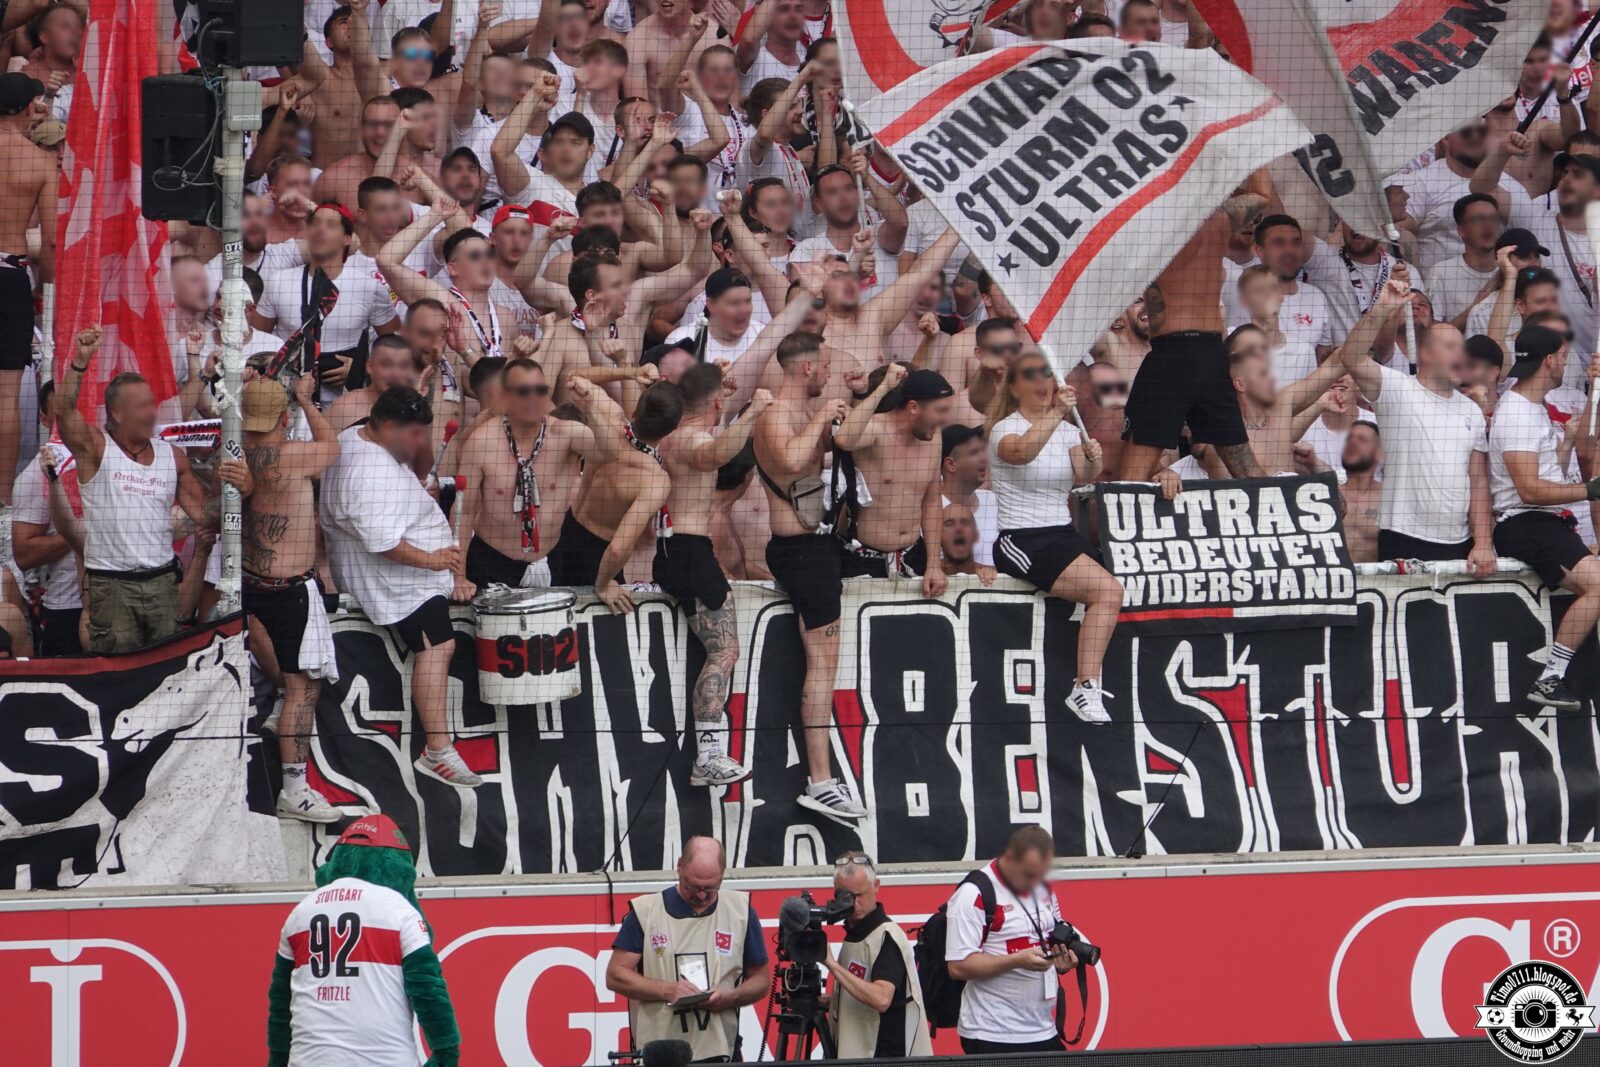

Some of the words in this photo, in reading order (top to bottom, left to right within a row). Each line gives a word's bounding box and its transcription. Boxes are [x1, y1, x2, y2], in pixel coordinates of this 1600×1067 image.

[955, 96, 1110, 242] STURM
[1007, 104, 1188, 267] ULTRAS
[1103, 482, 1338, 541] ULTRAS
[1108, 532, 1343, 574] BEDEUTET
[1115, 567, 1355, 607] WIDERSTAND
[315, 888, 363, 905] STUTTGART
[309, 912, 361, 978] 92
[317, 986, 351, 1001] FRITZLE
[673, 1008, 711, 1033] TV
